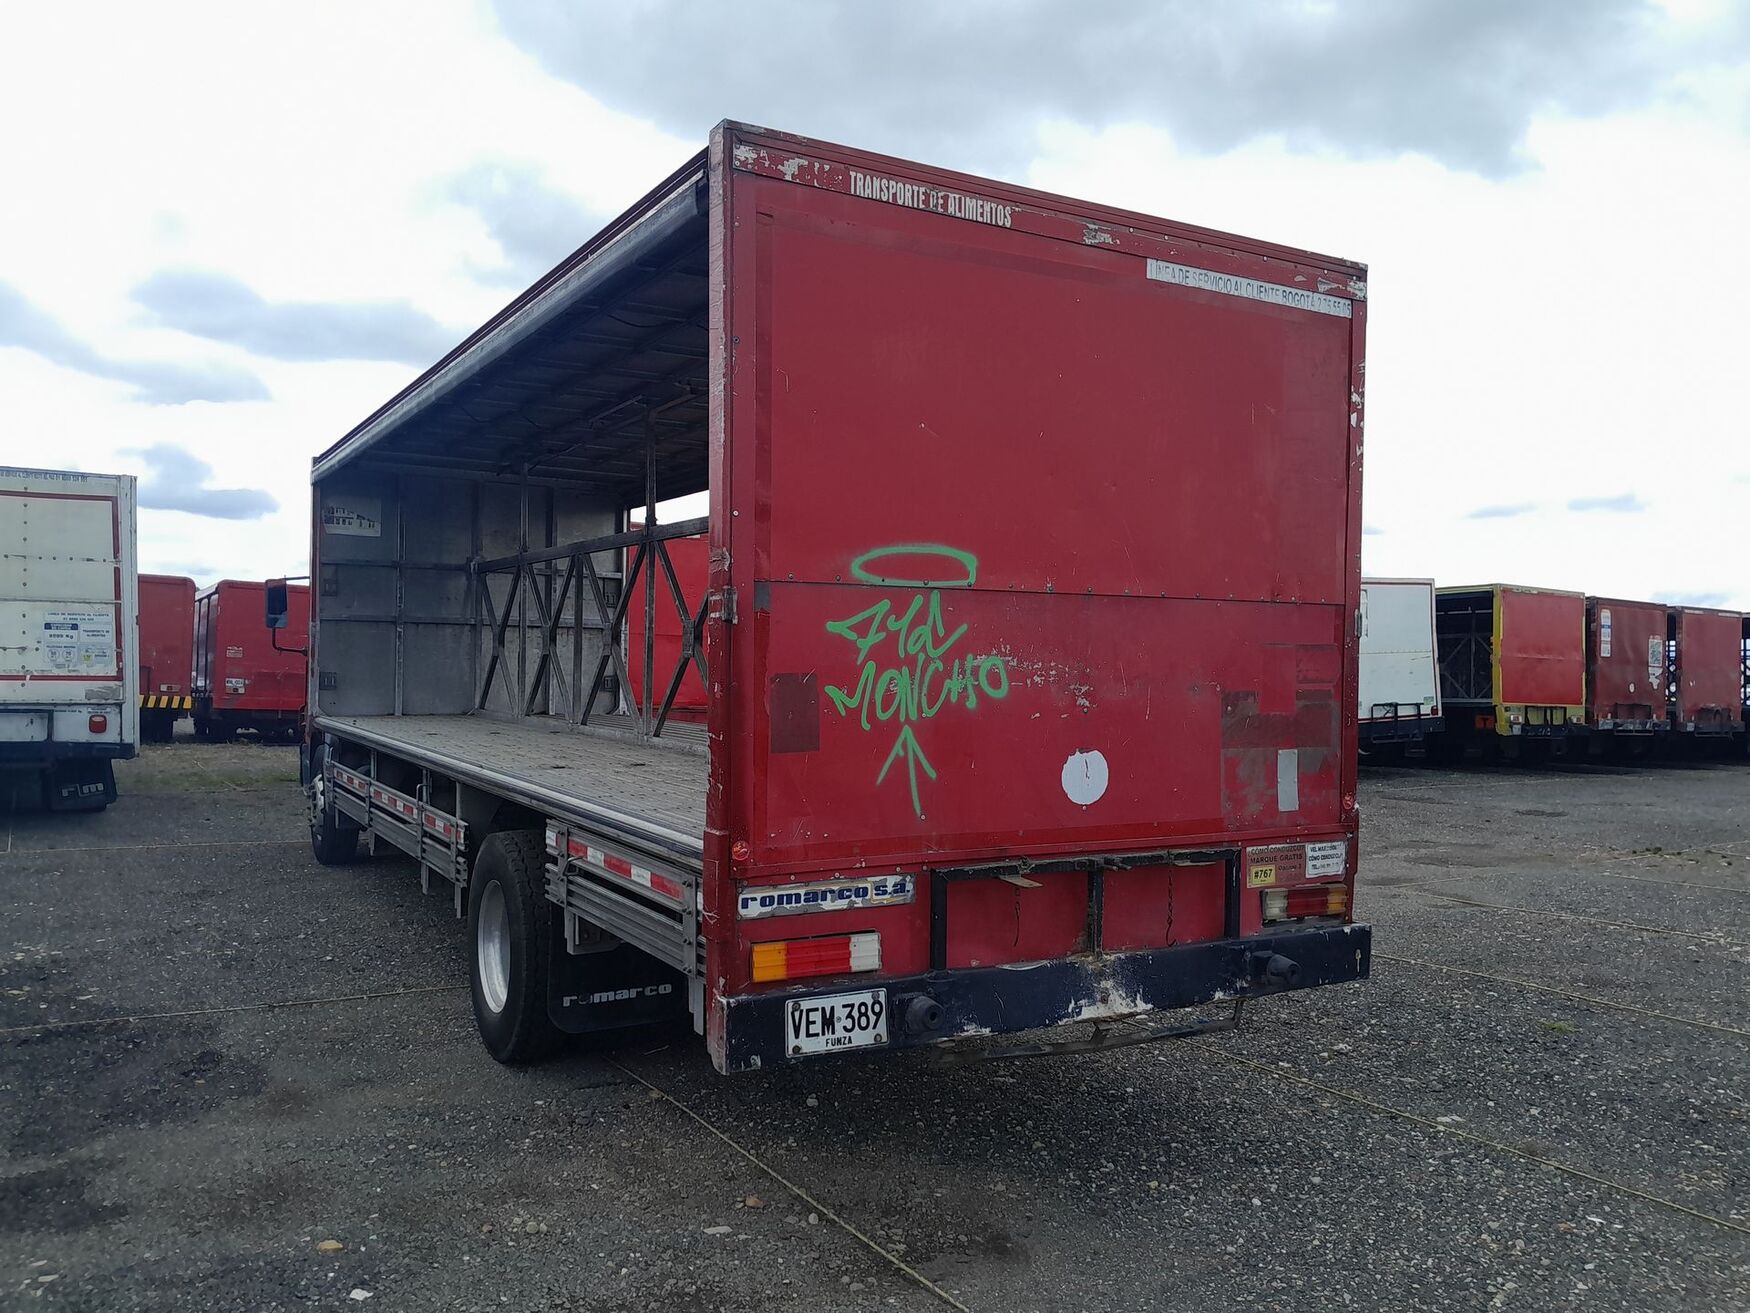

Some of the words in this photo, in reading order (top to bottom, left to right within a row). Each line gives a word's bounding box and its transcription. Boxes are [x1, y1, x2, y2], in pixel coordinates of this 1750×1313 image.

[849, 170, 926, 209] TRANSPORTE
[929, 190, 944, 213] DE
[947, 192, 1012, 228] ALIMENTOS
[1178, 268, 1190, 286] DE
[1191, 271, 1233, 295] SERVICIO
[1234, 279, 1243, 297] AL
[1245, 282, 1281, 303] CLIENTE
[1282, 290, 1315, 310] BOGOTÁ
[824, 652, 1010, 730] MONCHO
[1250, 856, 1278, 864] MARQUE
[1279, 852, 1303, 861] GRATIS
[1254, 868, 1272, 879] #767
[741, 885, 869, 909] romarco
[791, 1005, 836, 1040] VEM
[842, 1000, 884, 1034] 389
[825, 1035, 853, 1048] FUNZA
